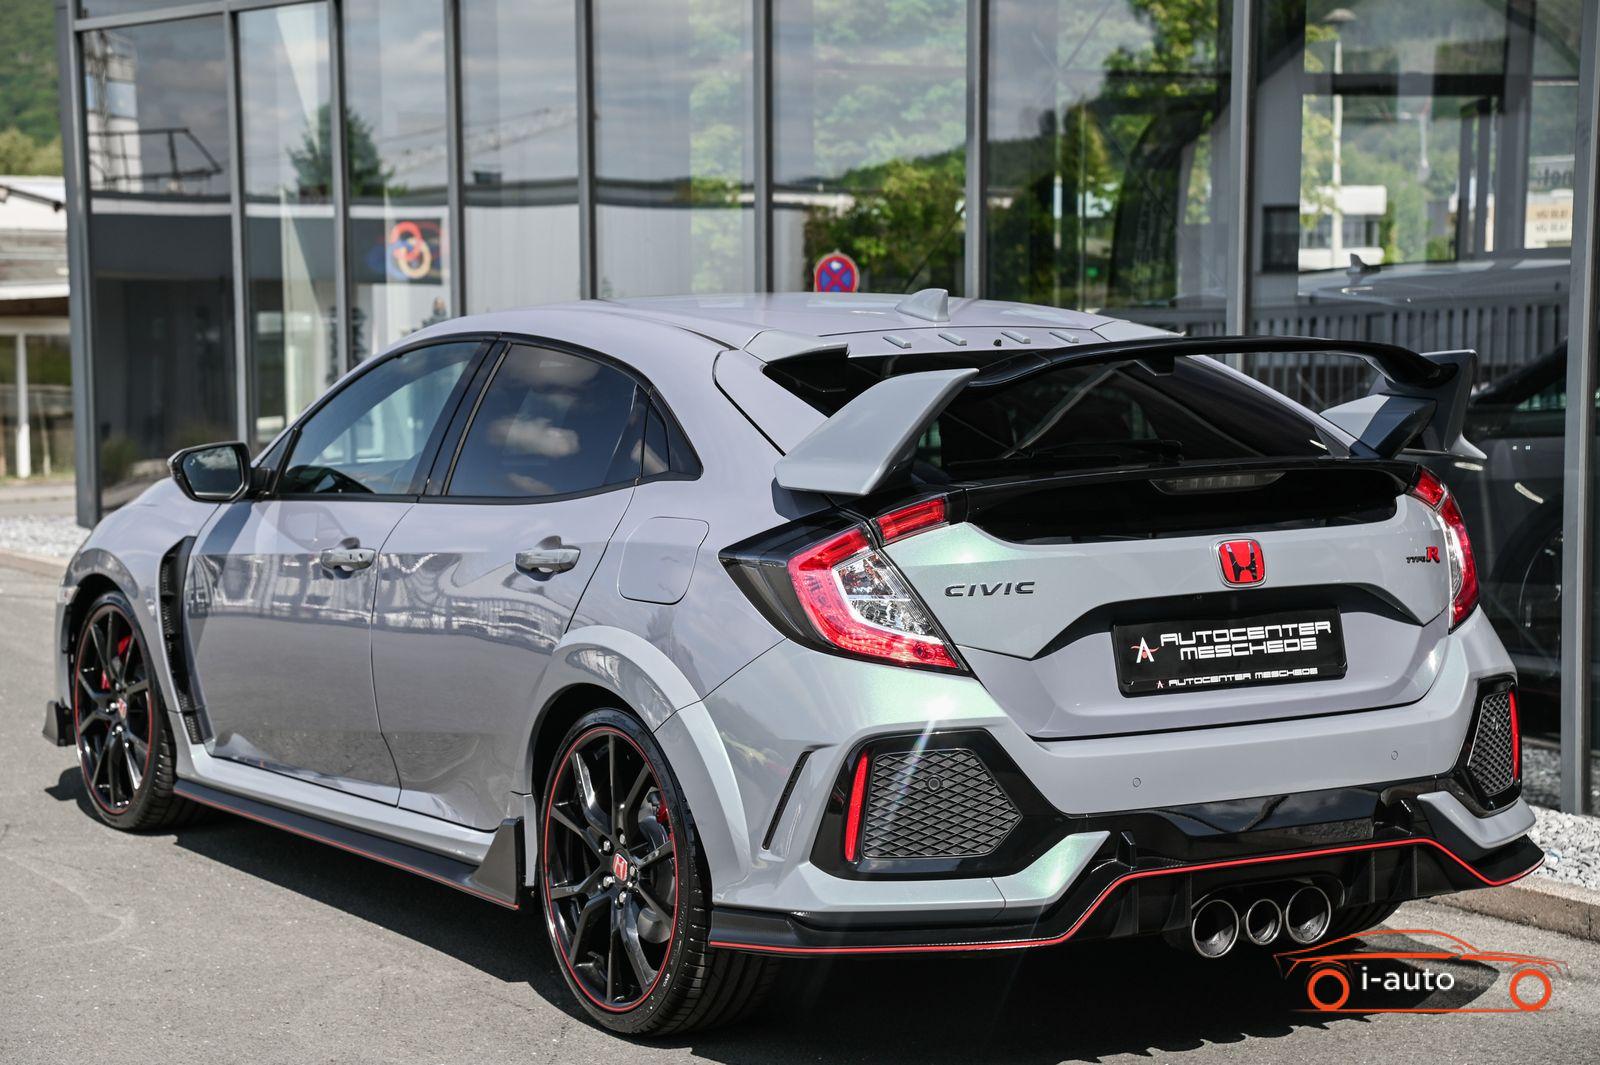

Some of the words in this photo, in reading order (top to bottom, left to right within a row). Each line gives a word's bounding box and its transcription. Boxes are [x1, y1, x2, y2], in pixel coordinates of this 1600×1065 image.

[1425, 546, 1440, 564] R
[944, 581, 1035, 597] CIVIC
[1160, 620, 1332, 647] AUTOCENTER
[1180, 637, 1318, 661] MESCHEDE
[1168, 672, 1252, 687] AUTOCENTER
[1254, 667, 1319, 679] MESCHEDE
